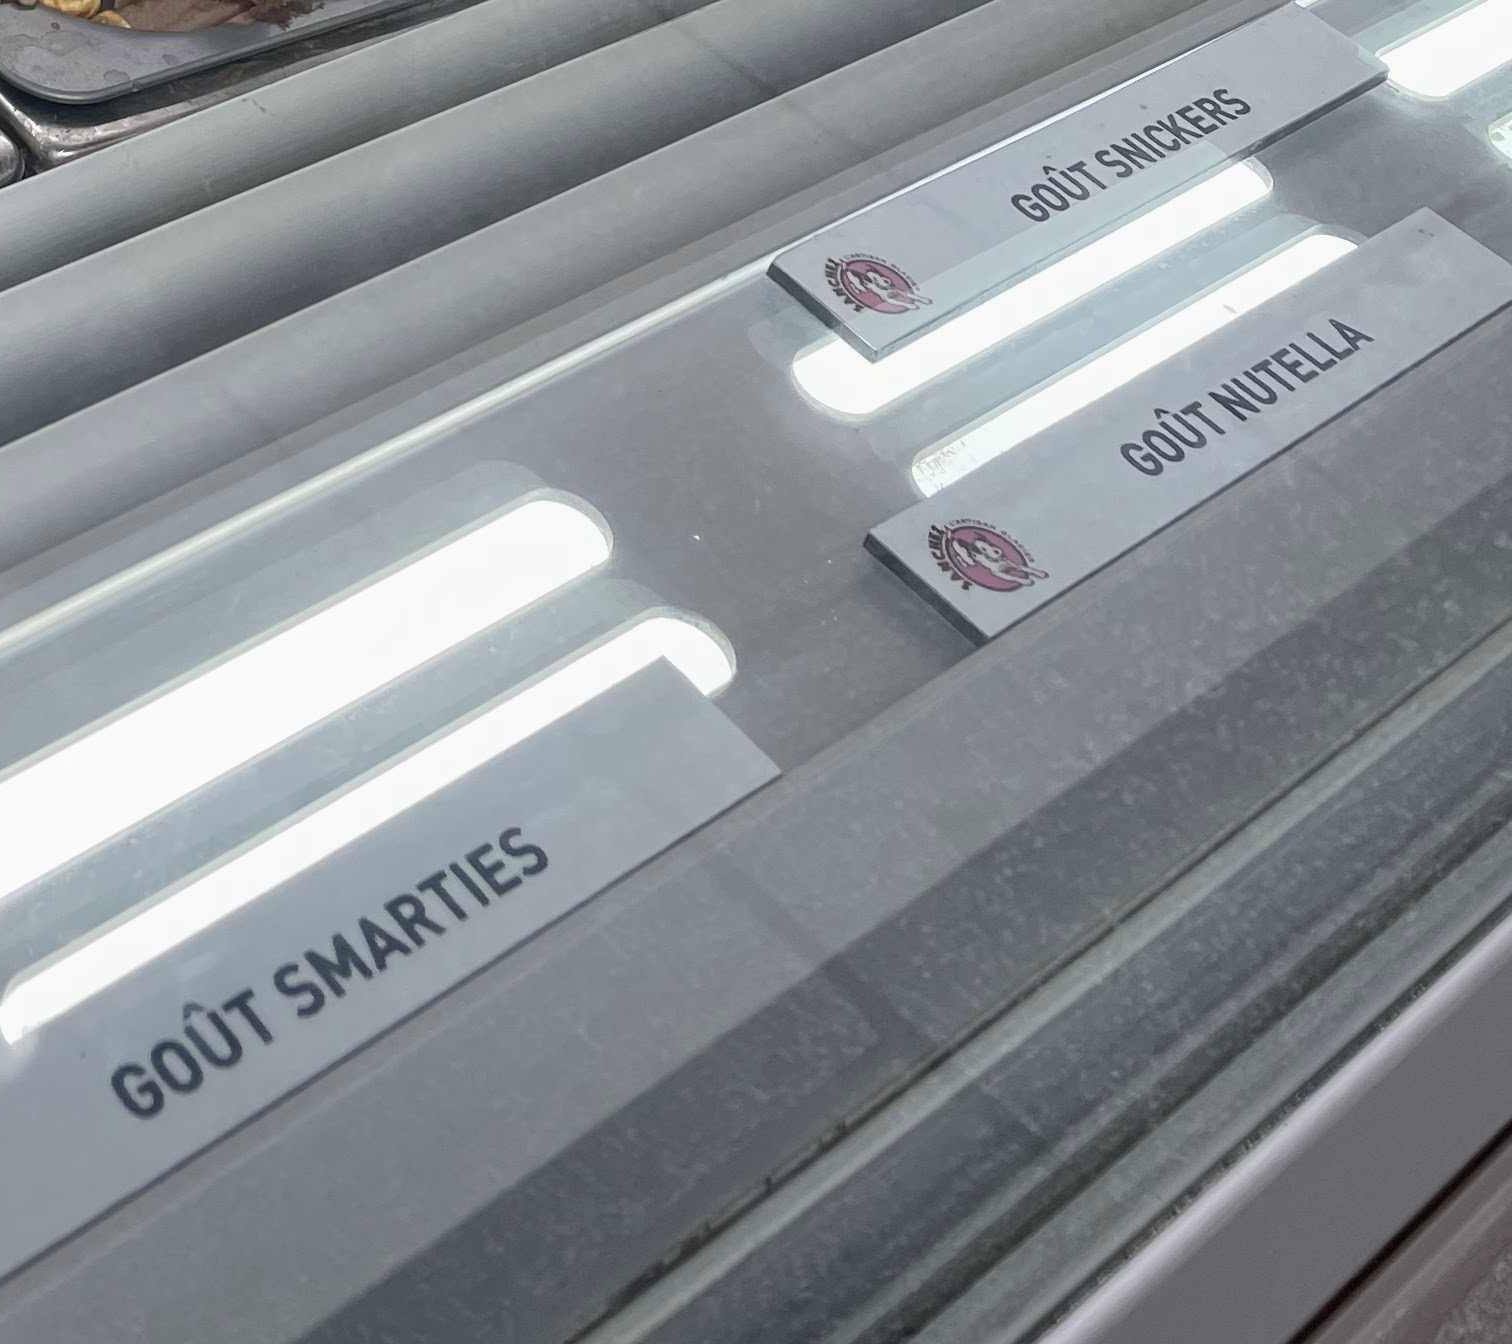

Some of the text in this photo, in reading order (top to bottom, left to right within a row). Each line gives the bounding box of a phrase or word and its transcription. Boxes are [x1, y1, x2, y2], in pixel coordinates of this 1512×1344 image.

[1010, 88, 1252, 223] GOÛT SNICKERS
[1119, 318, 1375, 477] GOÛT NUTELLA
[110, 826, 549, 1121] GOÛT SMARTIES
